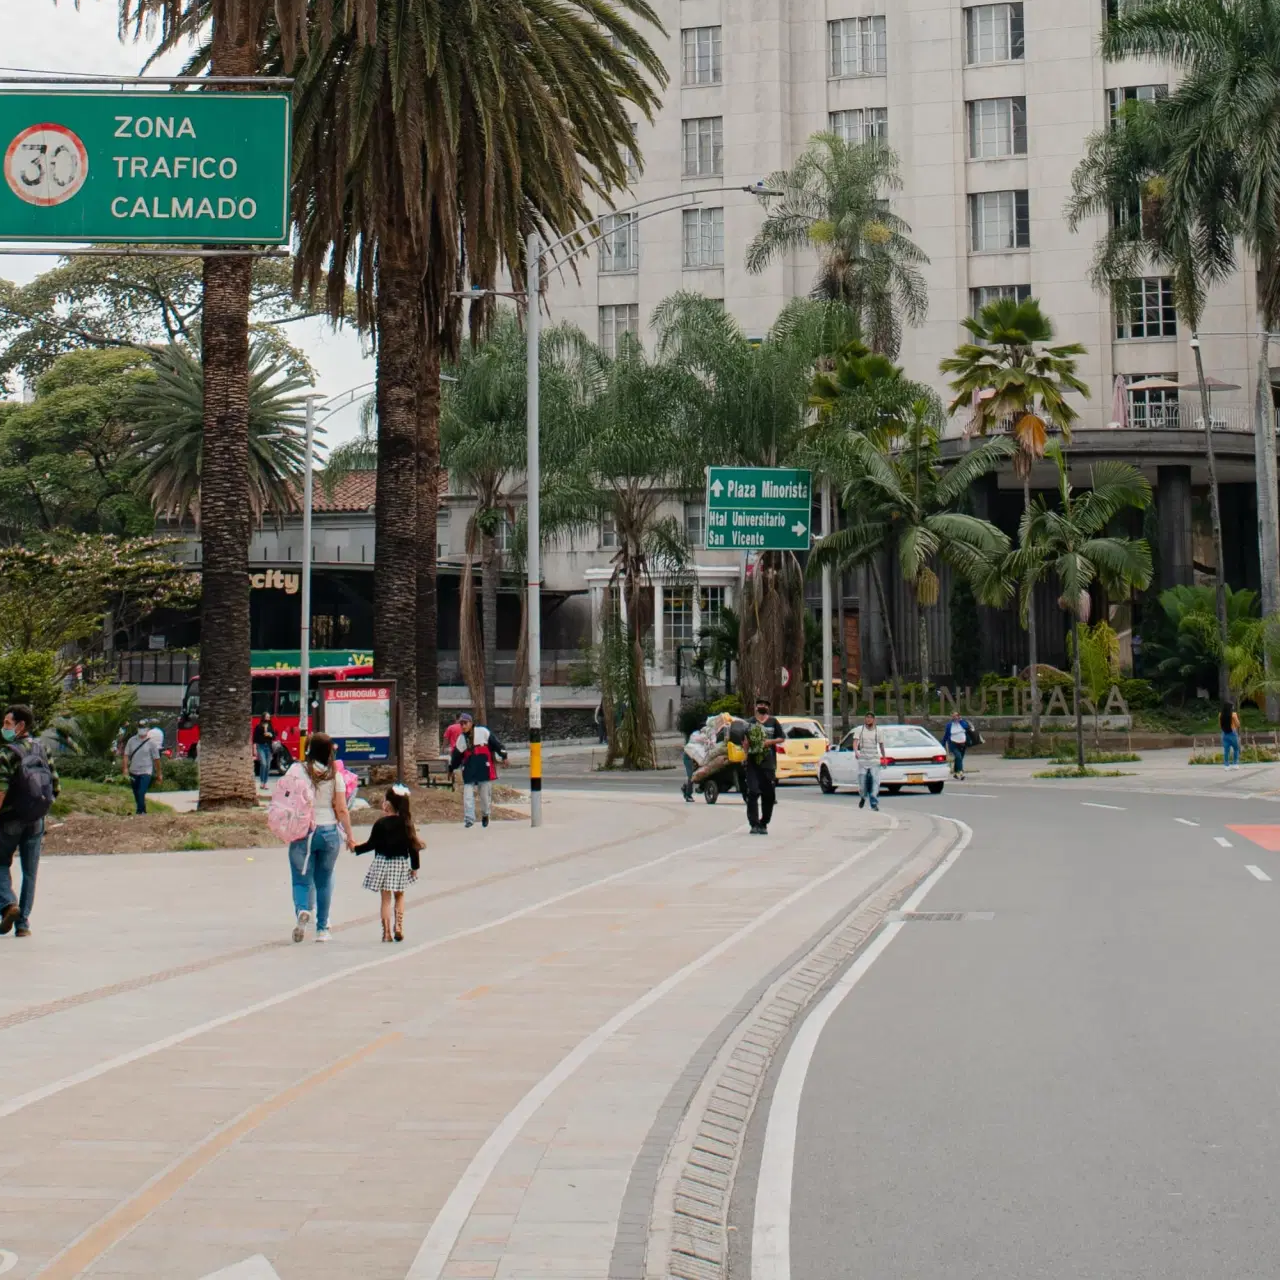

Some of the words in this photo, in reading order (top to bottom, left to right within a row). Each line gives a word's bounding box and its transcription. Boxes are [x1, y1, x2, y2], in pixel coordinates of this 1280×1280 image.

[113, 115, 197, 139] ZONA
[21, 144, 78, 186] 30
[112, 156, 238, 179] TRAFICO
[110, 196, 258, 220] CALMADO
[727, 479, 756, 499] Plaza
[761, 480, 808, 499] Minorista
[709, 511, 728, 527] Htal
[732, 511, 786, 527] Universitario
[708, 530, 725, 546] San
[731, 530, 765, 546] Vicente
[249, 569, 300, 595] city
[336, 688, 377, 699] CENTROGUÍA
